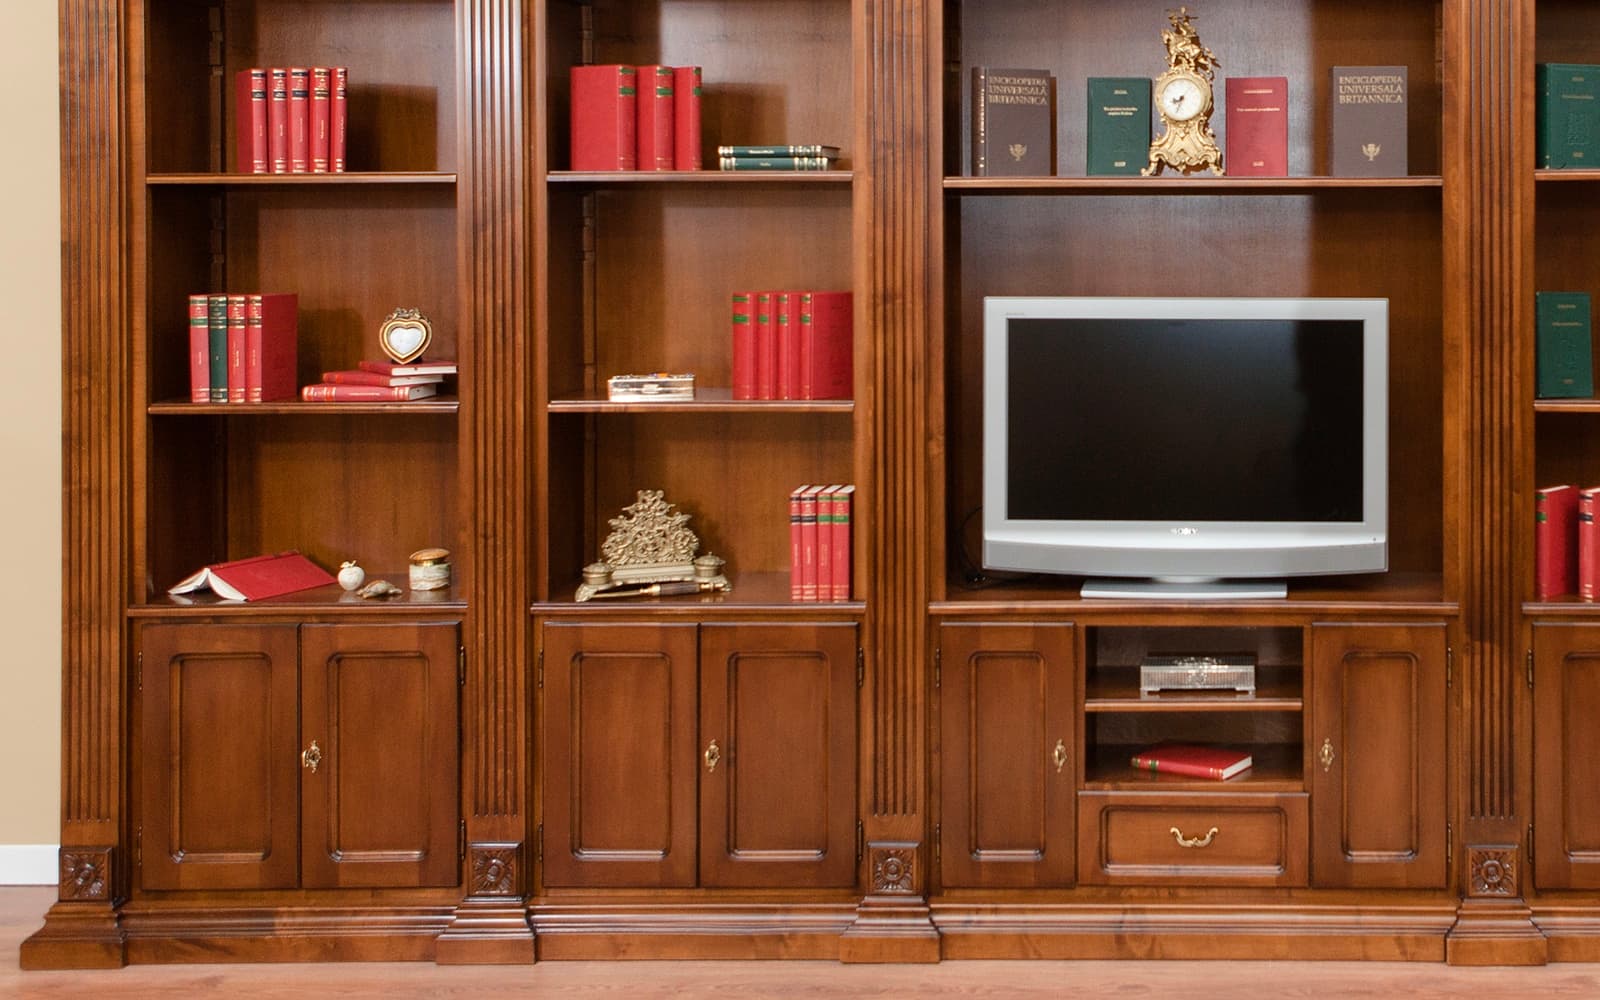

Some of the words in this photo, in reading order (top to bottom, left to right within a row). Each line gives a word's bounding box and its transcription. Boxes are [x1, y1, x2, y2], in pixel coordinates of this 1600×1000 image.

[1339, 76, 1403, 84] ENCICLOPEDIA
[989, 95, 1048, 105] BRITANNICA
[1339, 95, 1403, 104] BRITANNICA
